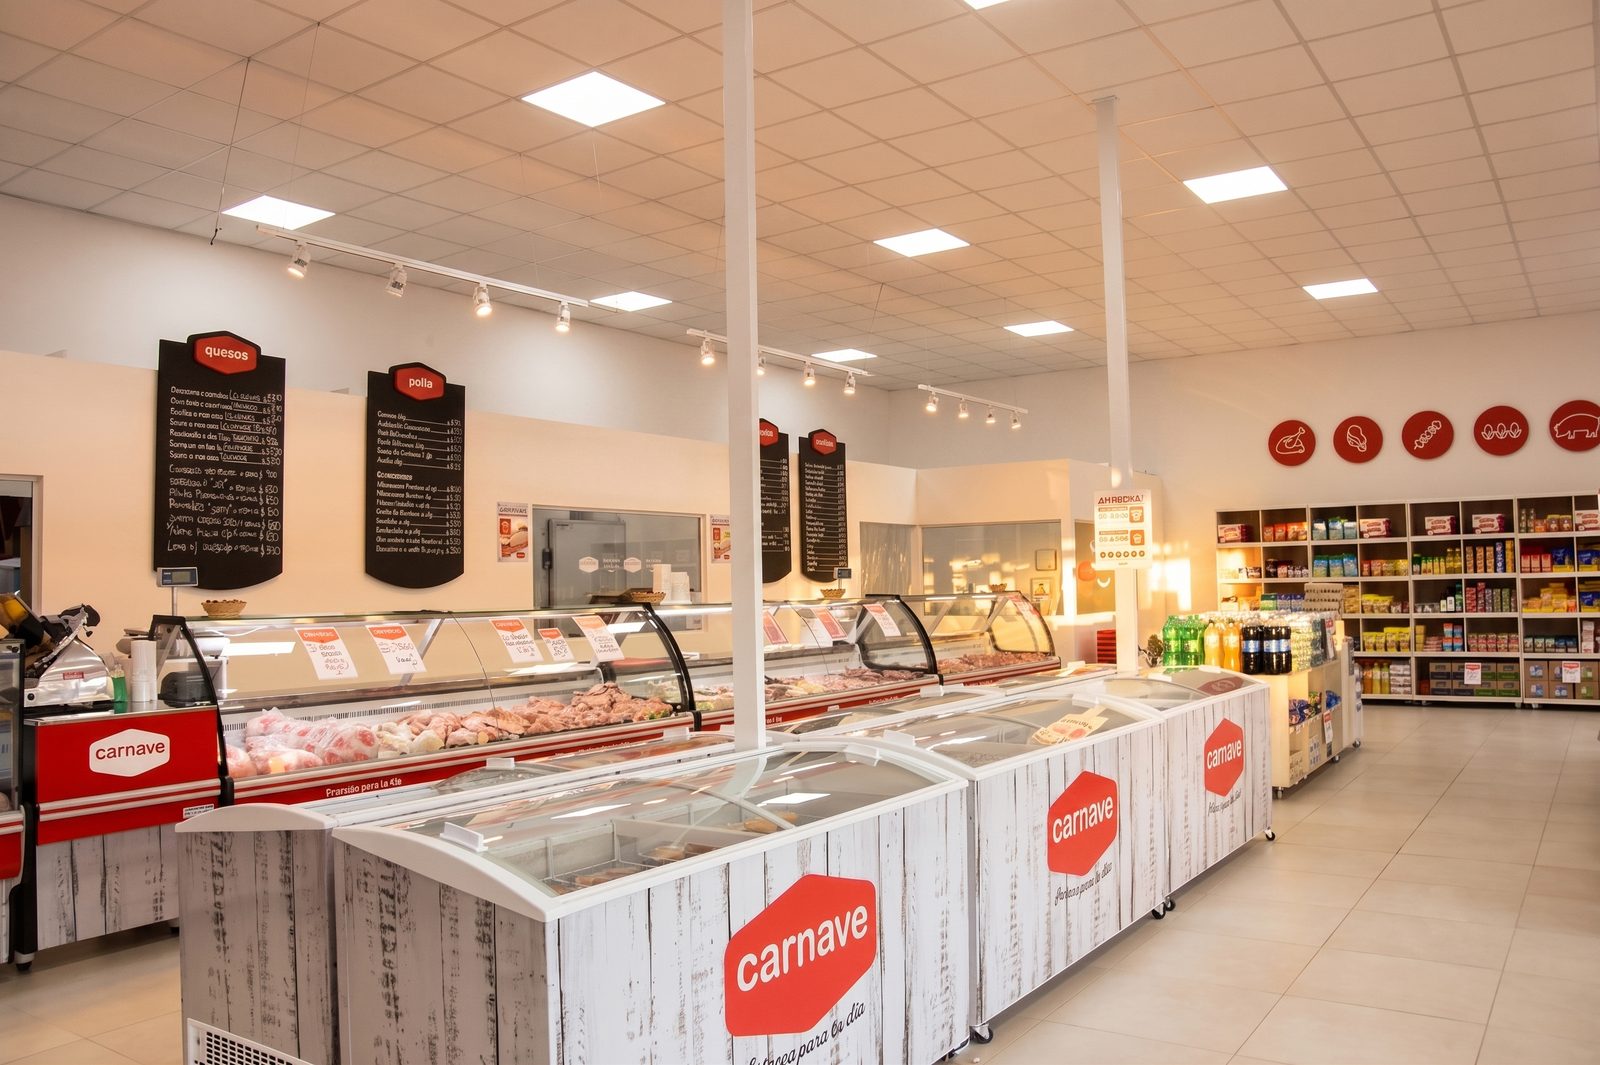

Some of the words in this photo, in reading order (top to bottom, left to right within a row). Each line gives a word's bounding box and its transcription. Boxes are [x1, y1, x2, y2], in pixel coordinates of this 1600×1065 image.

[205, 346, 249, 361] quesos
[95, 742, 165, 760] carnave
[1207, 739, 1242, 769] carnave
[1053, 796, 1114, 844] carnave
[737, 905, 869, 992] carnave
